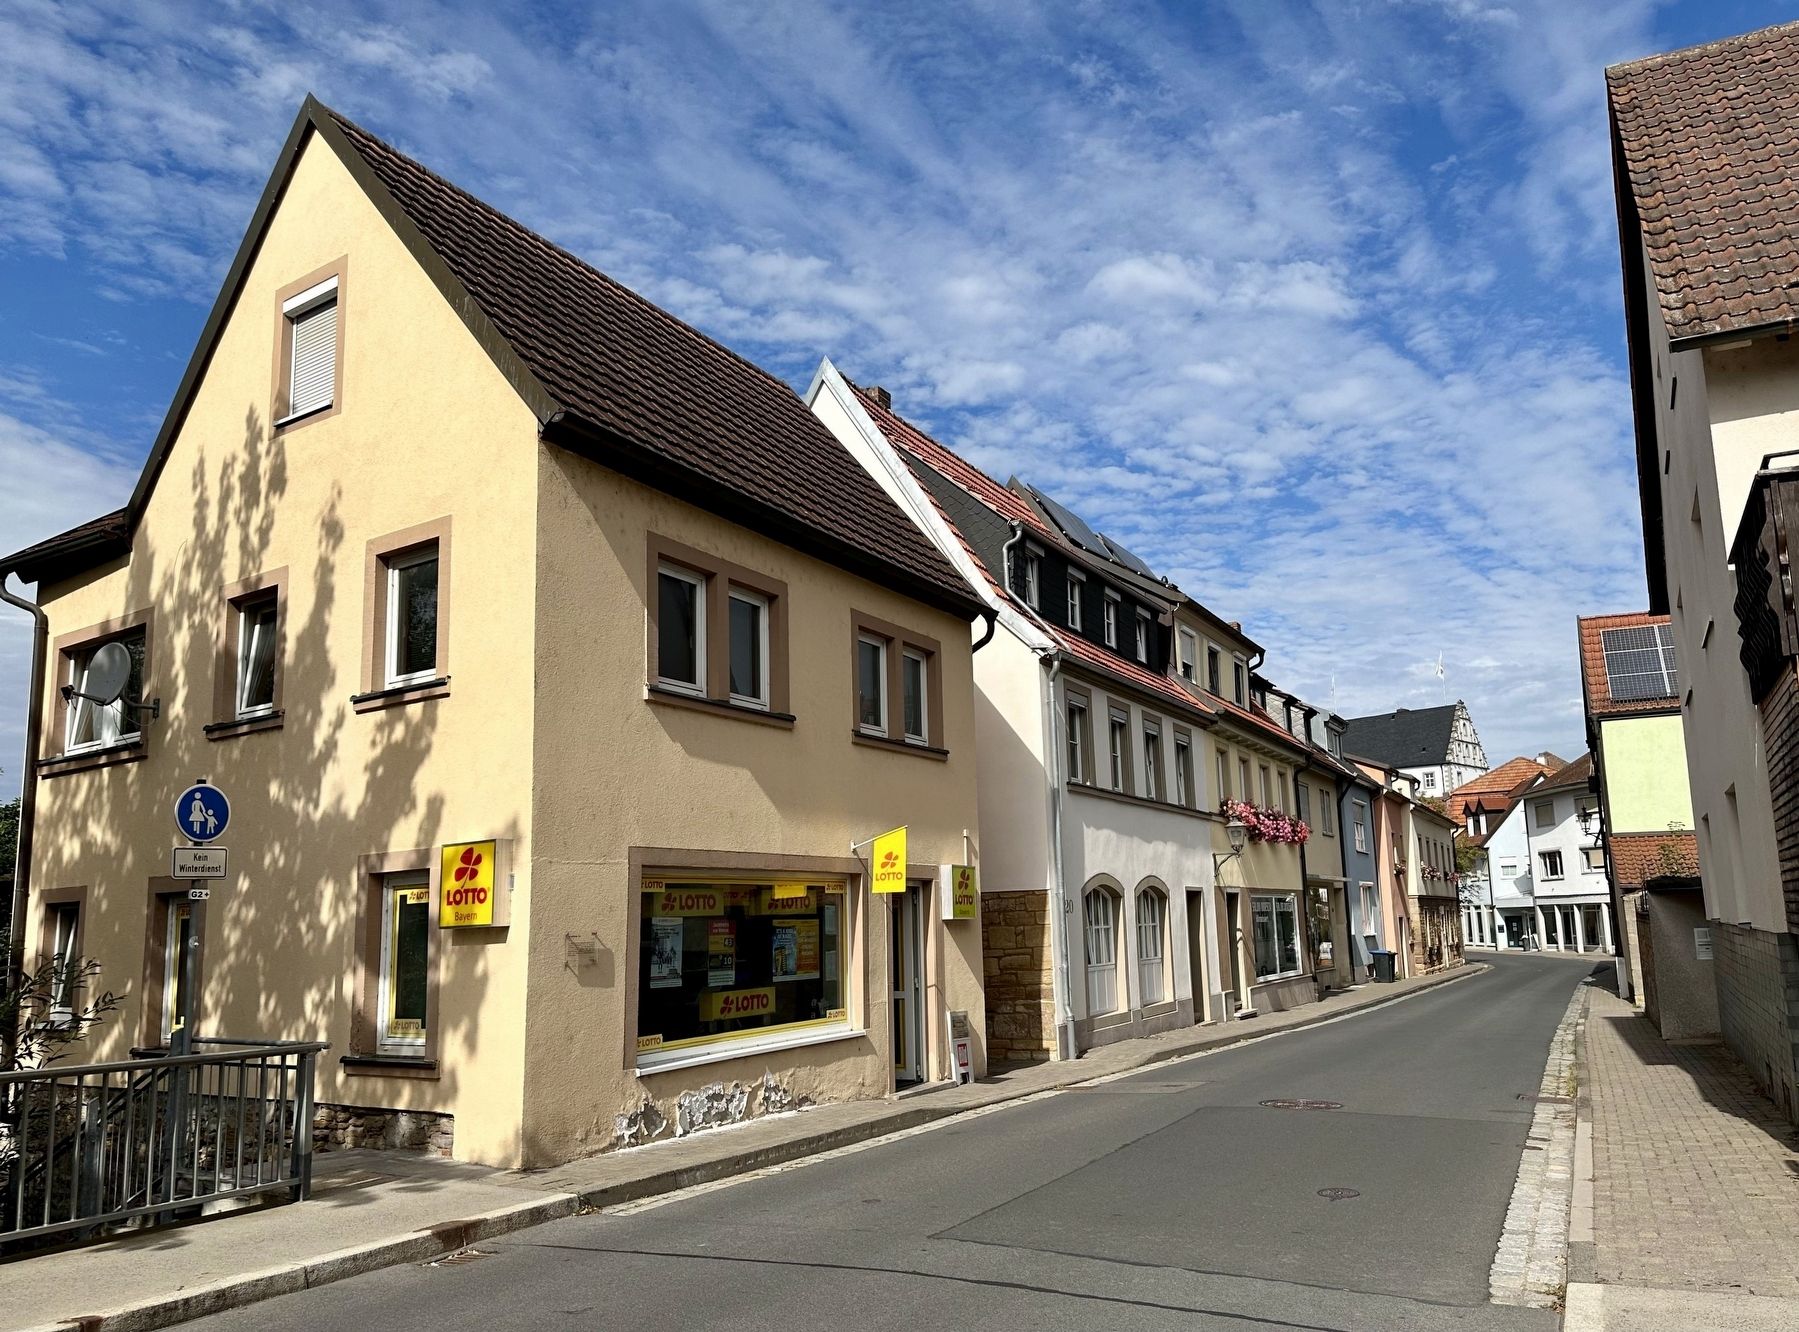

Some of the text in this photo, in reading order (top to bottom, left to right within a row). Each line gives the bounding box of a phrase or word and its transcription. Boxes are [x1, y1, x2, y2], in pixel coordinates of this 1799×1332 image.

[193, 853, 208, 862] Kein
[179, 864, 221, 873] Winterdienst
[876, 872, 903, 882] LOTTO
[644, 881, 664, 889] LOTTO
[446, 887, 487, 906] LOTTO
[955, 895, 973, 906] LOTTO
[678, 894, 716, 911] LOTTO
[781, 896, 811, 910] LOTTO
[454, 911, 478, 923] Bayern
[735, 993, 769, 1012] LOTTO
[401, 1020, 420, 1030] LOTTO
[641, 1036, 662, 1047] LOTTO
